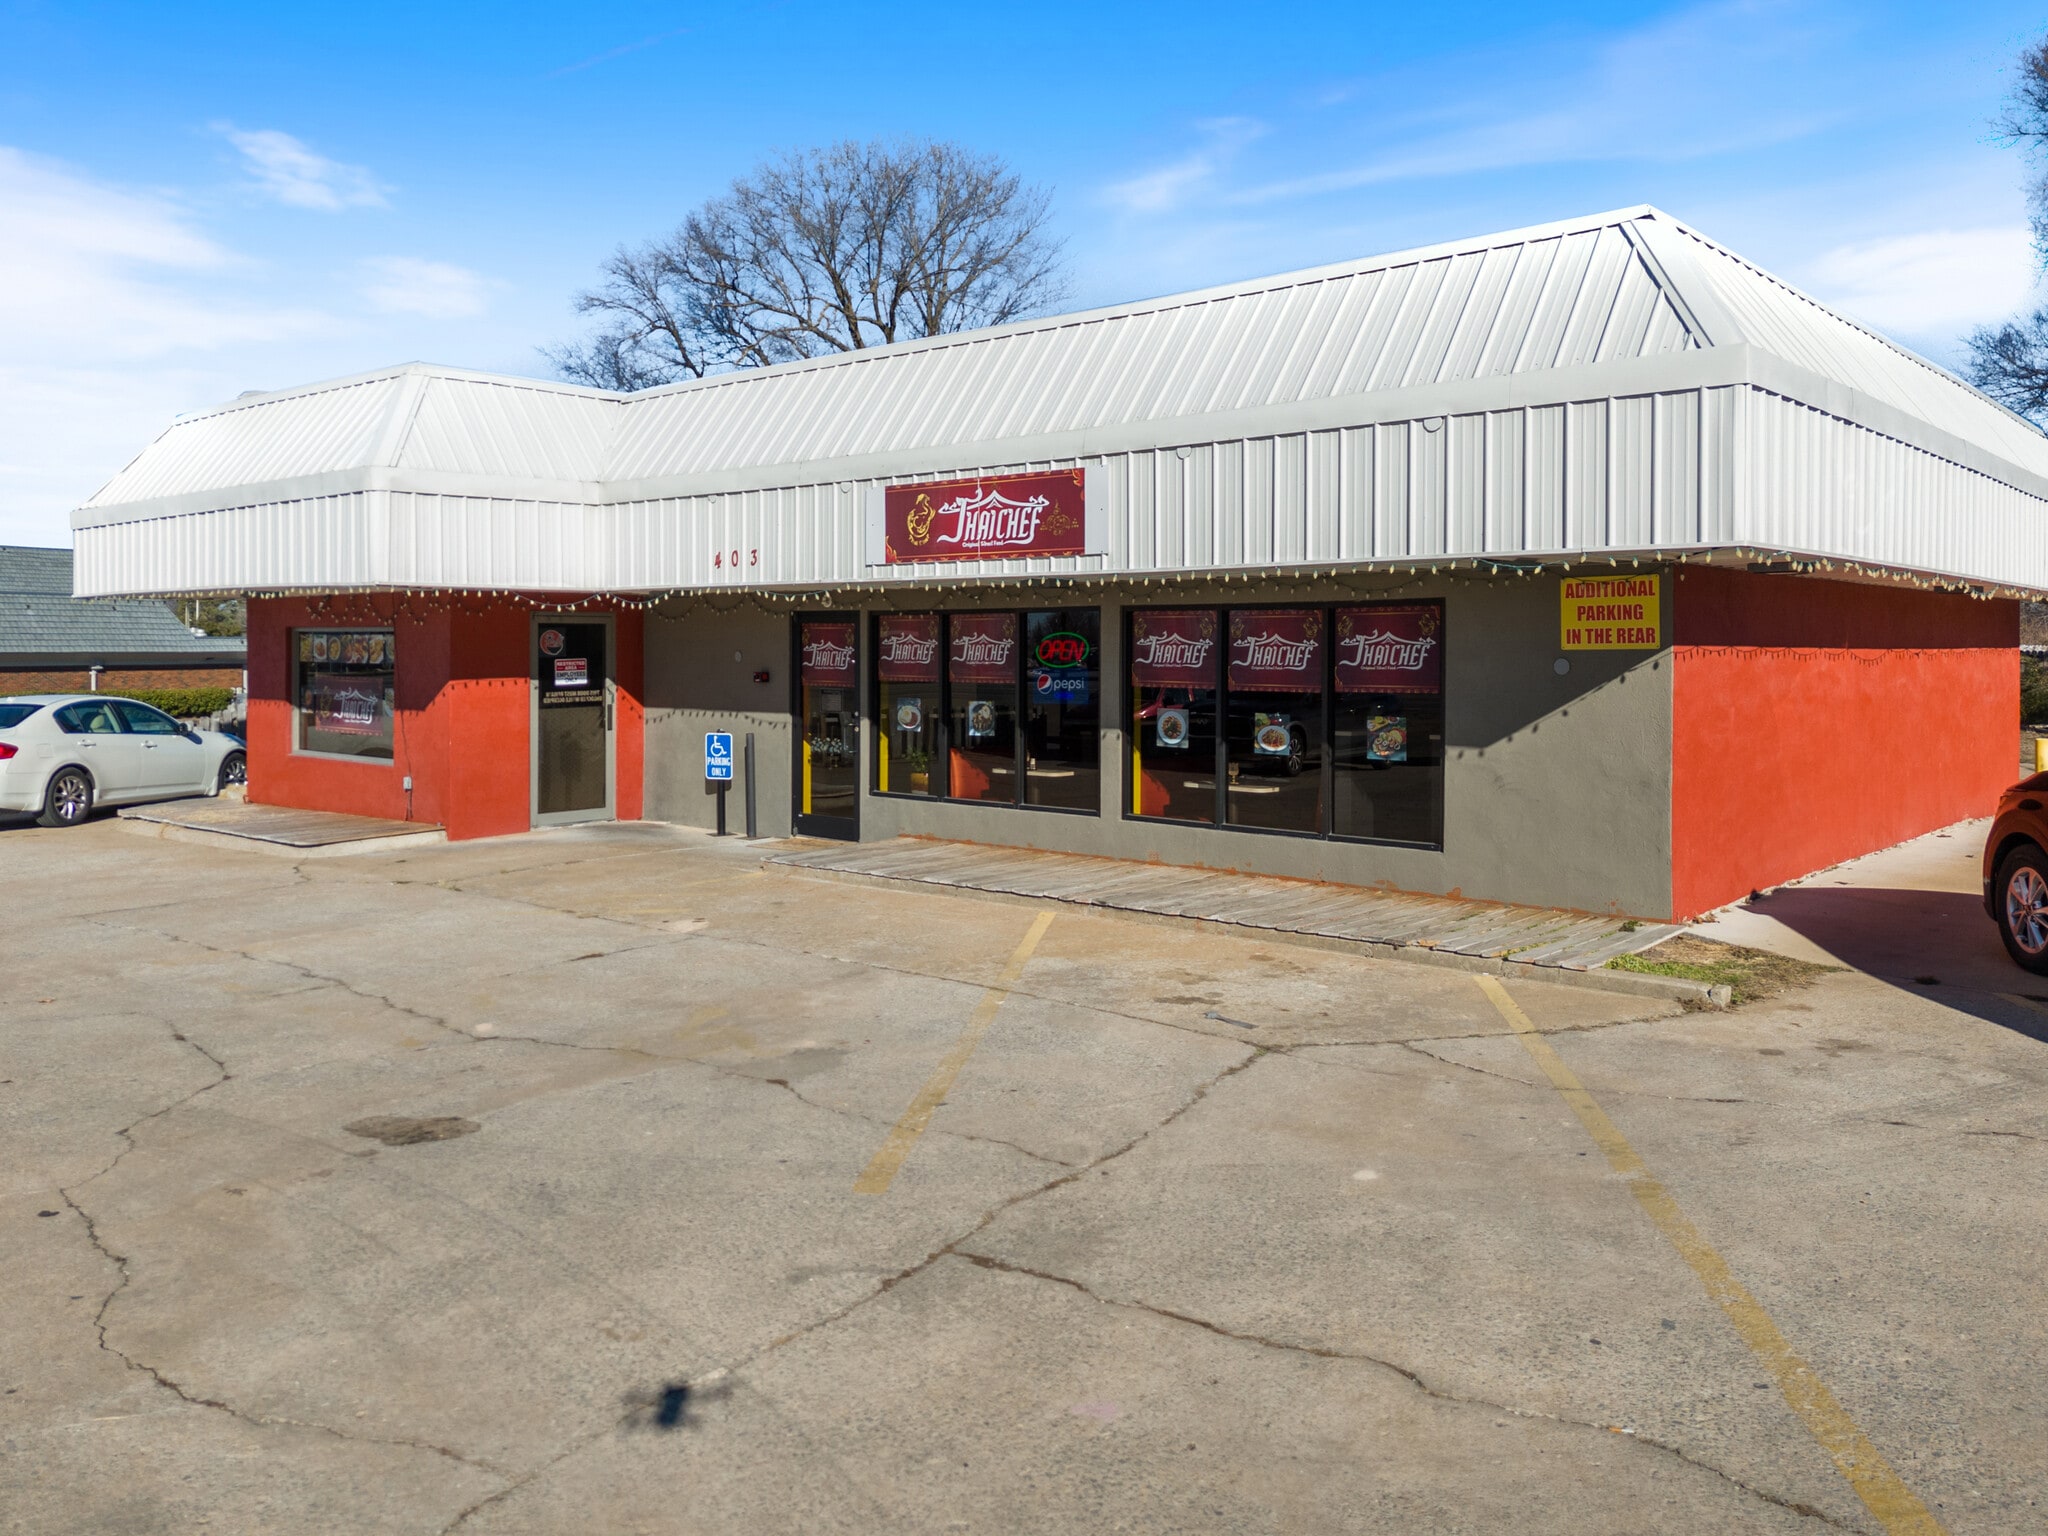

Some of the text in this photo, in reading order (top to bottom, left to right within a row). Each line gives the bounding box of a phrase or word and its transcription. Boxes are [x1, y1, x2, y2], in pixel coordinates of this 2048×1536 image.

[714, 549, 758, 569] 403
[1565, 580, 1656, 599] ADDITIONAL
[1577, 604, 1644, 621] PARKING
[1566, 627, 1656, 645] IN THE REAR
[1039, 639, 1085, 661] OPEN
[1053, 677, 1085, 691] pepsi
[711, 767, 727, 776] ONLY
